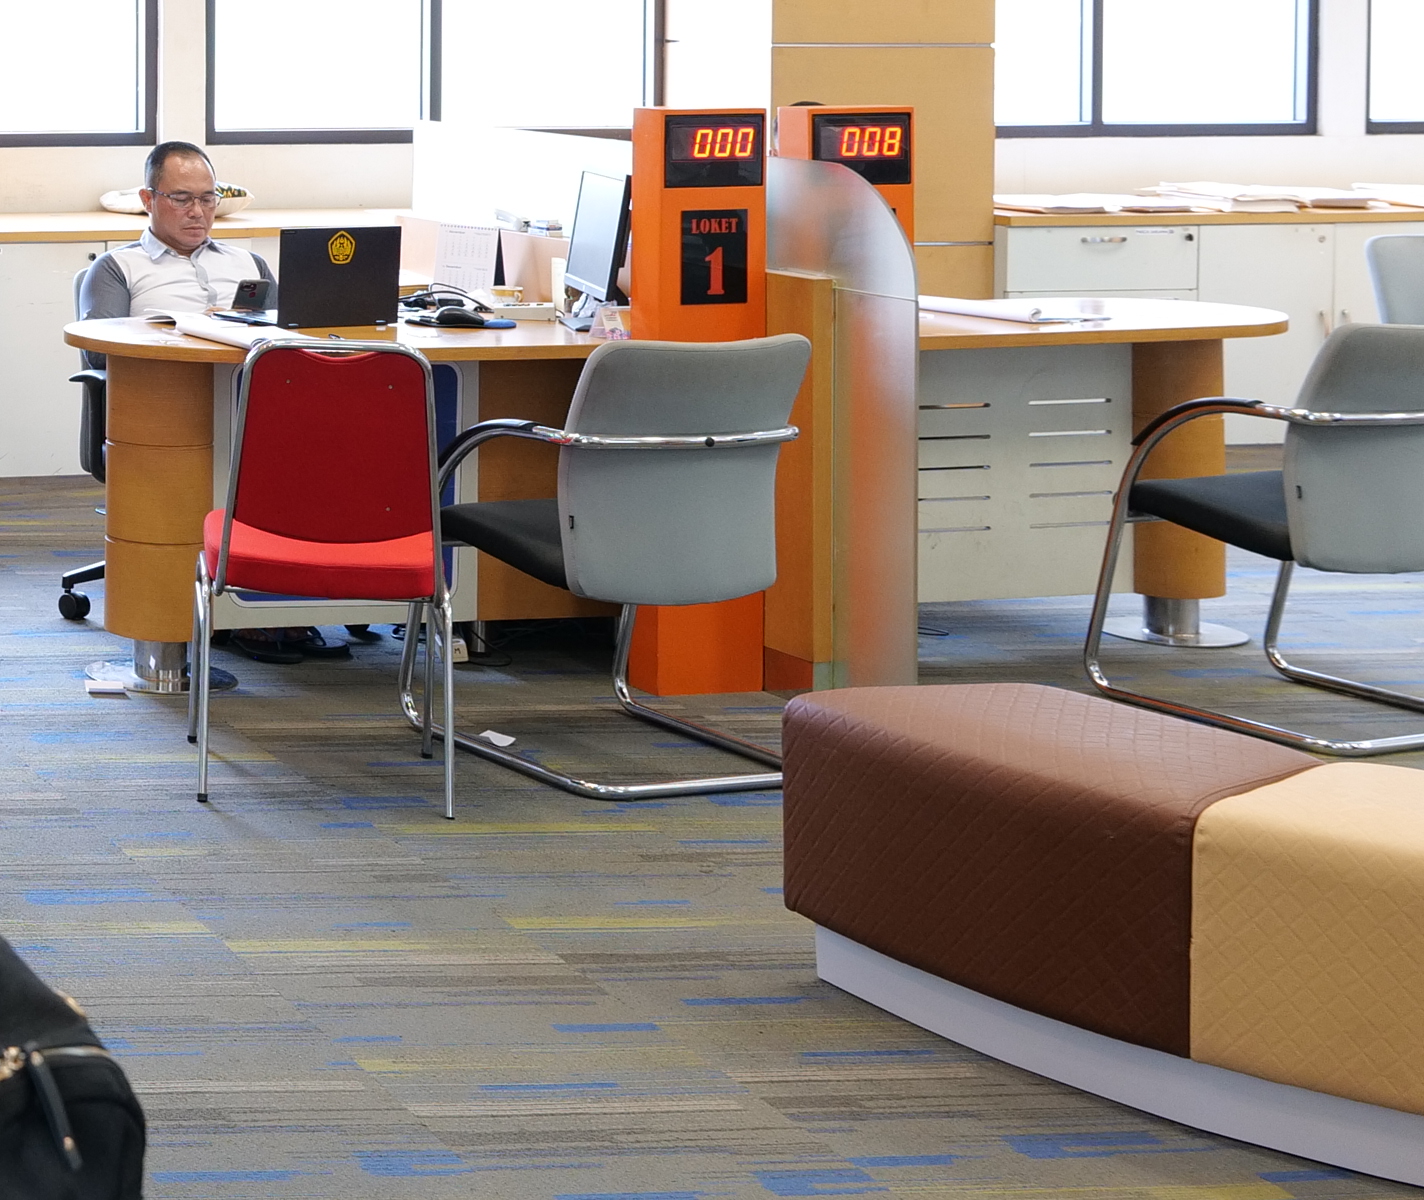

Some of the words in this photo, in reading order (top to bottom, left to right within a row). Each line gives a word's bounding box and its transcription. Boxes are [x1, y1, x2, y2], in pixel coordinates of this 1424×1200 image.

[693, 128, 754, 158] 000
[841, 127, 902, 157] 008
[691, 218, 739, 234] LOKET
[704, 246, 725, 295] 1
